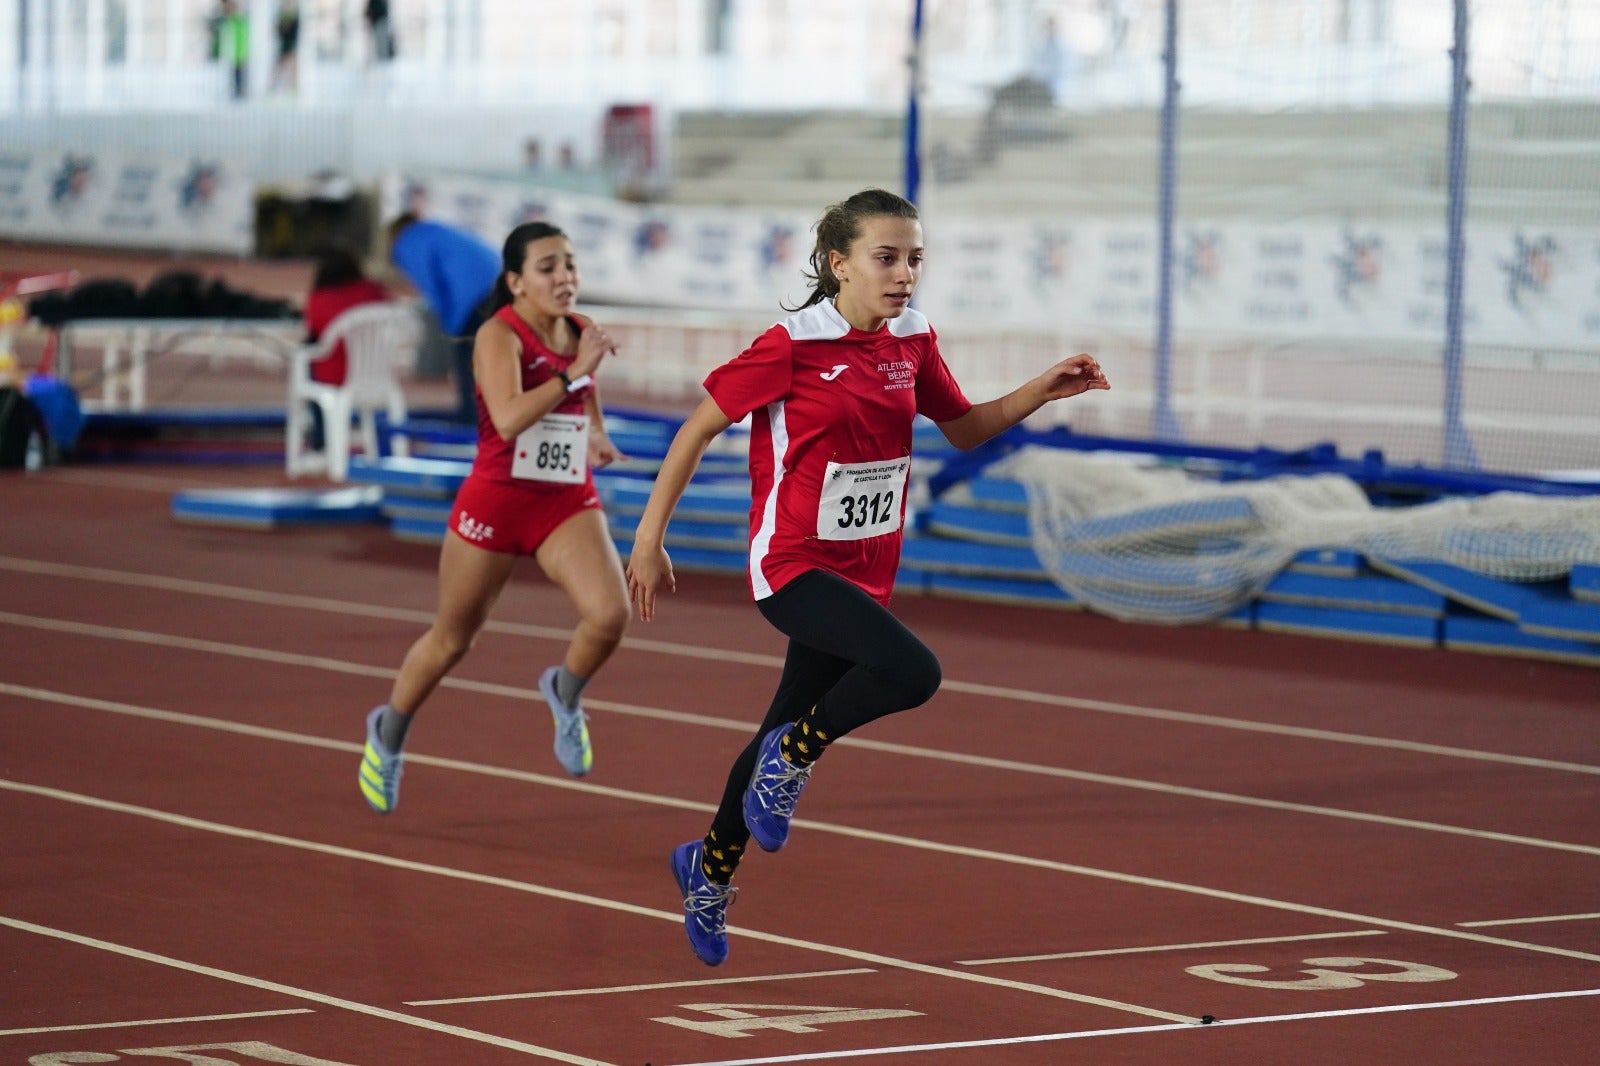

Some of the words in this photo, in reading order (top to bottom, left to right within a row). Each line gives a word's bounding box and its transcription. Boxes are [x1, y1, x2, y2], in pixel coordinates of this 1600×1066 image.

[537, 440, 571, 471] 895
[838, 491, 894, 528] 3312
[1183, 956, 1459, 992] 3
[649, 1002, 927, 1039] 4
